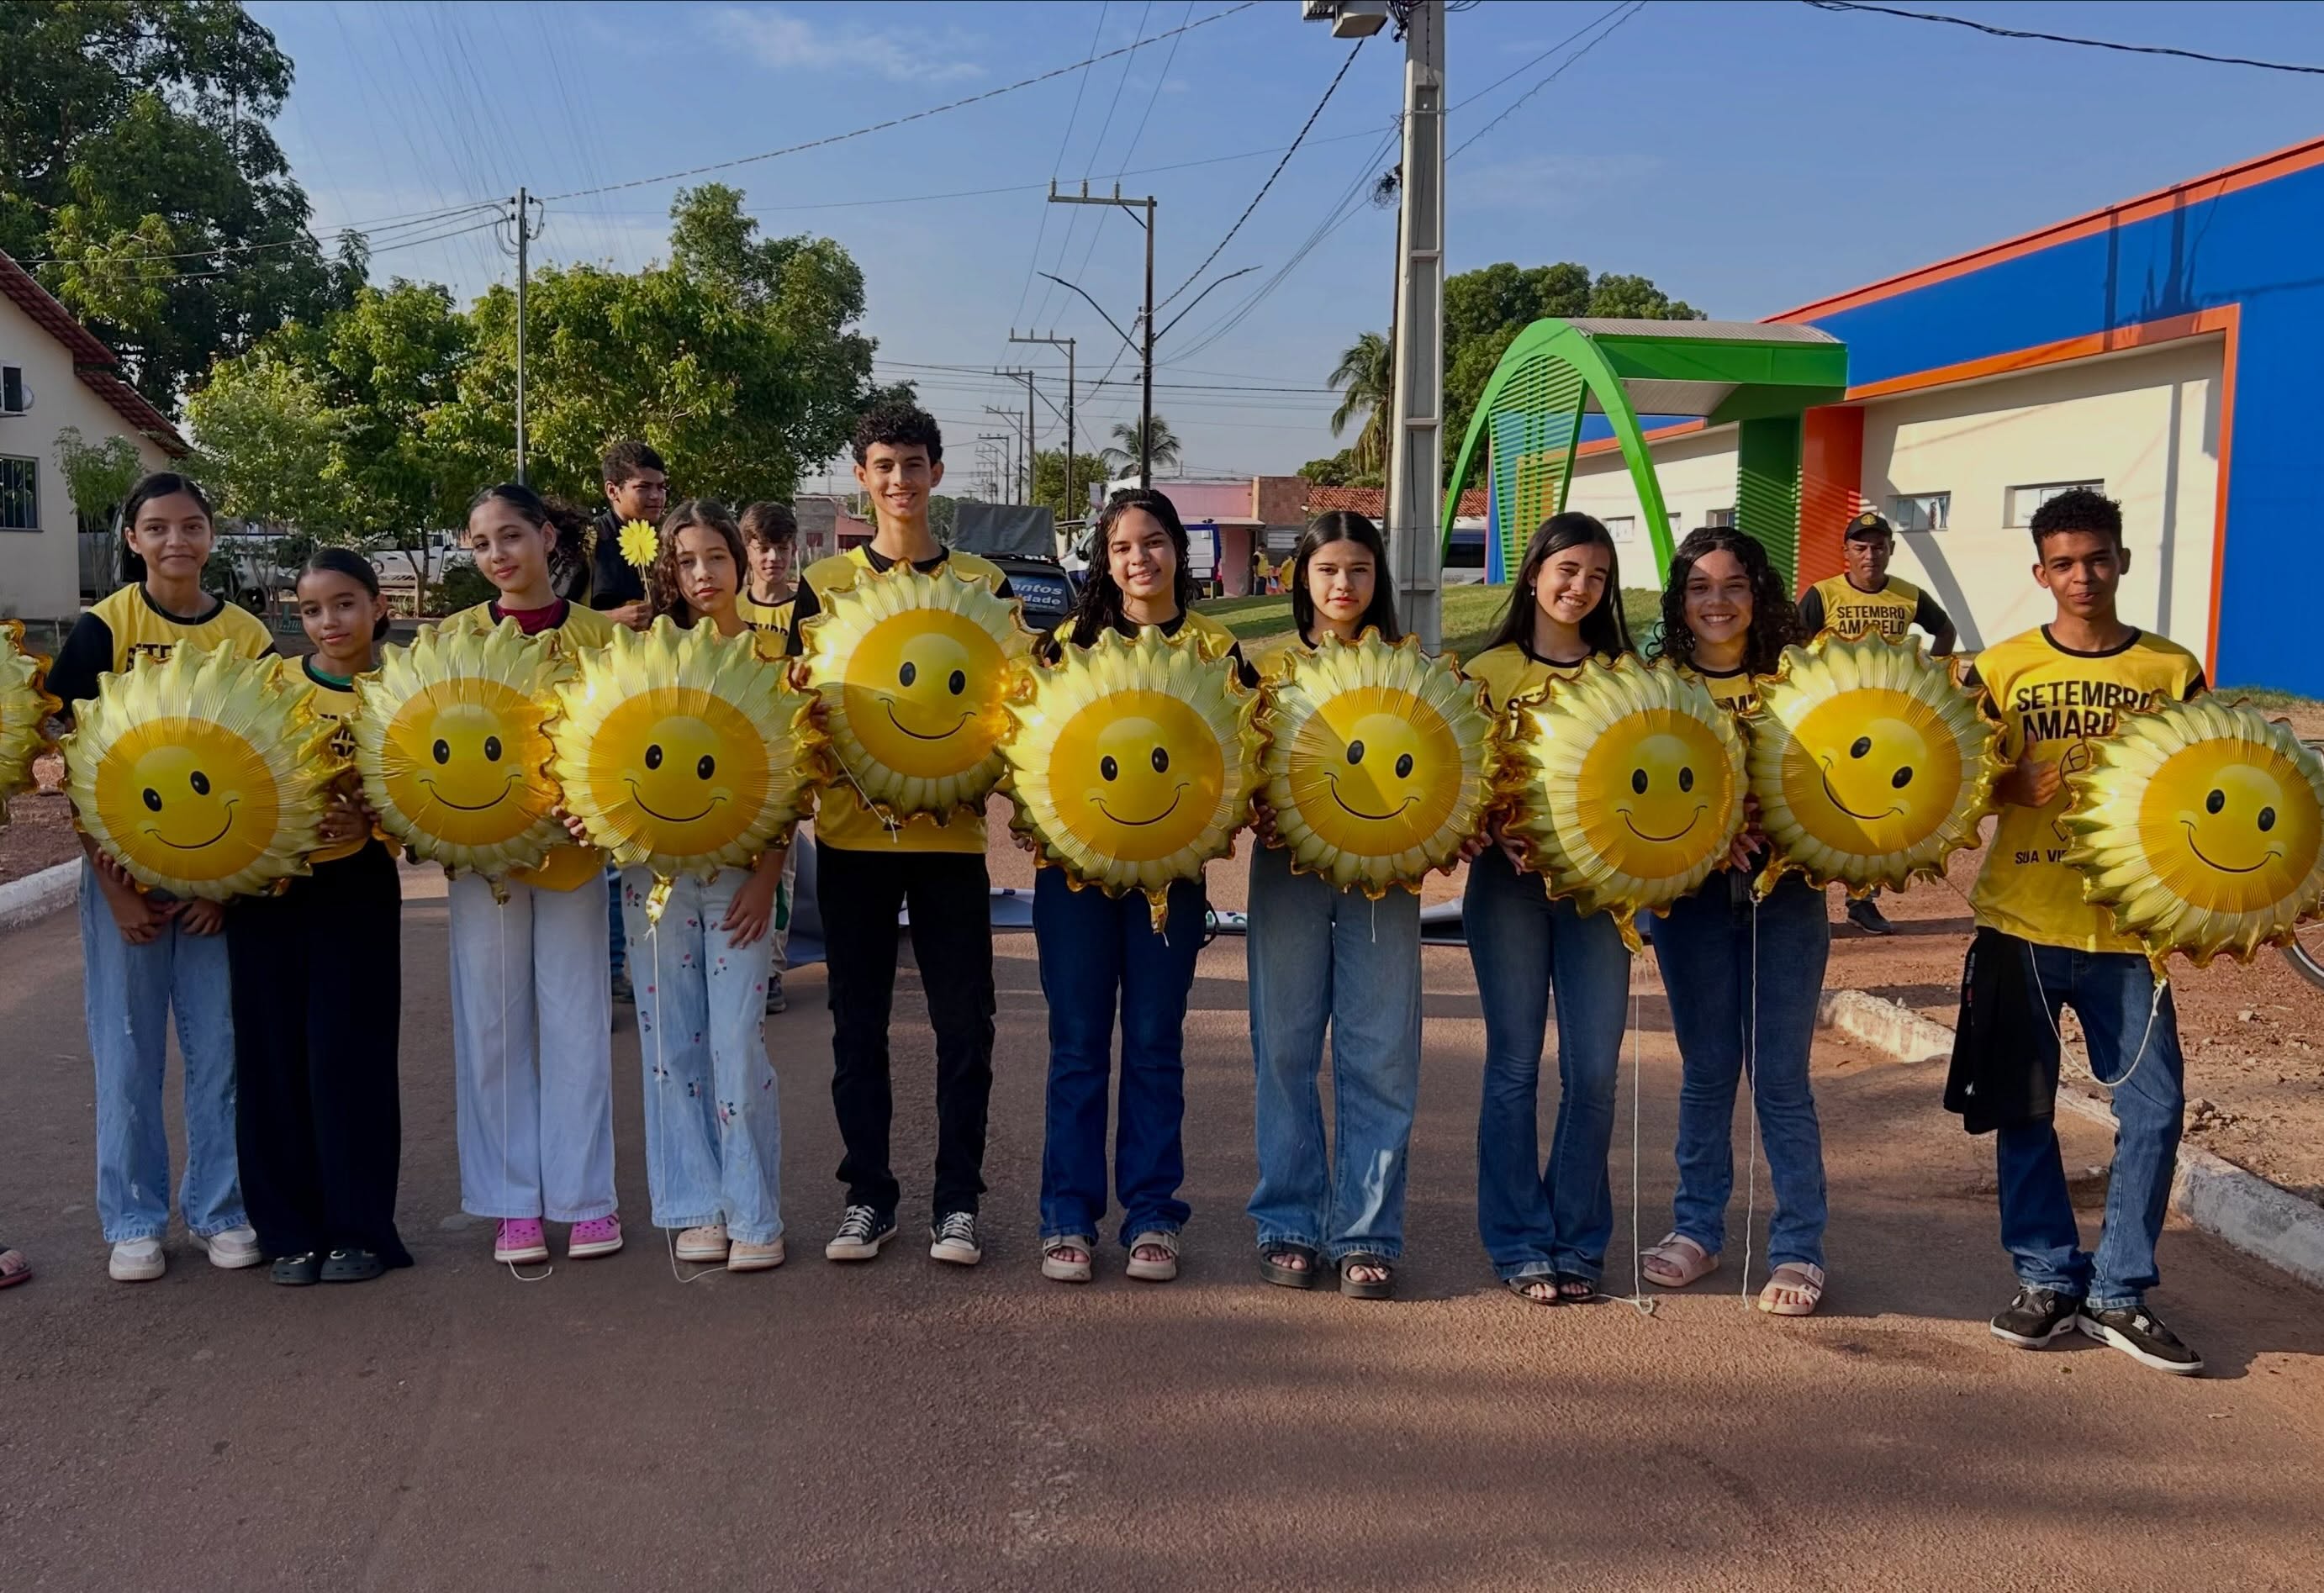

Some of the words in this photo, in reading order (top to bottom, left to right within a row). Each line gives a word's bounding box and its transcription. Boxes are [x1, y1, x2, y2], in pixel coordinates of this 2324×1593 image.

[1836, 605, 1905, 620] SETEMBRO
[2015, 850, 2039, 864] SUA
[2047, 849, 2068, 862] VI
